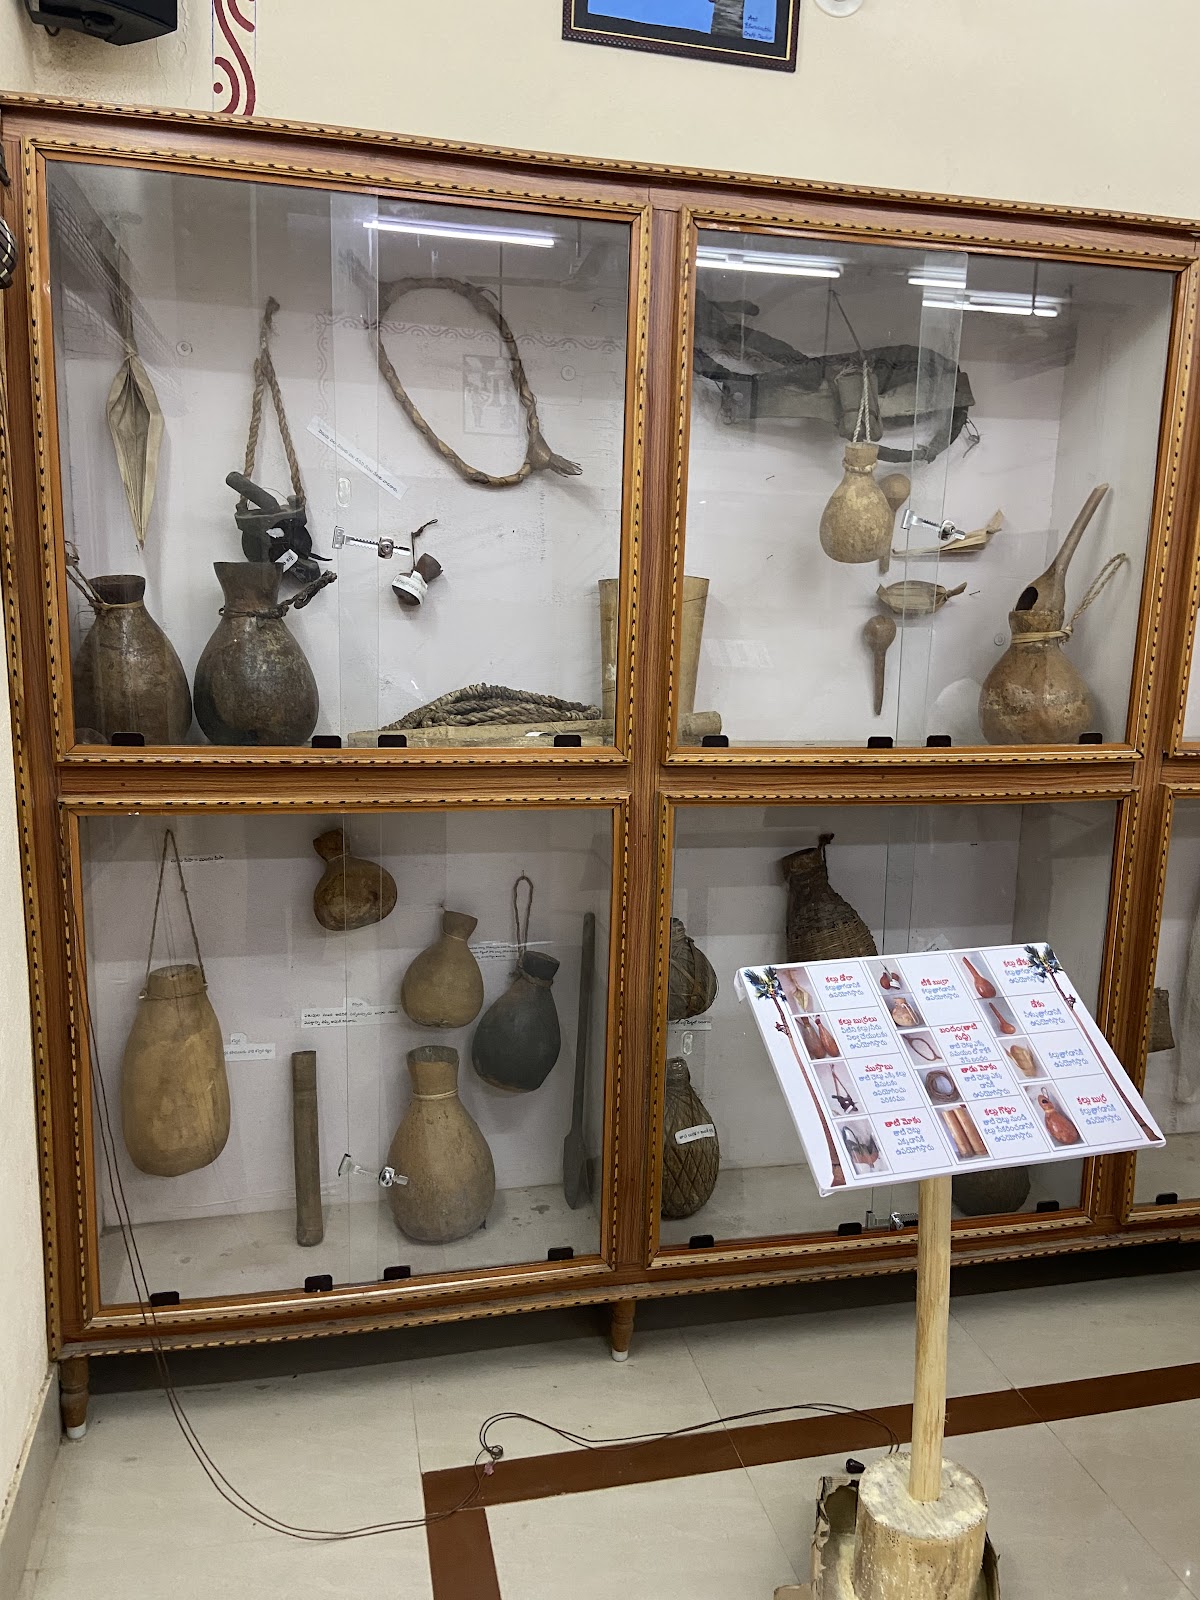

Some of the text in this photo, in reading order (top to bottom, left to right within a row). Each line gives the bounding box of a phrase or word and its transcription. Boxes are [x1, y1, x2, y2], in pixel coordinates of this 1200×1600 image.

[825, 976, 839, 984] కల్లు
[838, 1018, 852, 1026] కల్లు
[1076, 1095, 1091, 1105] కల్లు
[984, 1108, 998, 1116] కల్లు
[884, 1118, 900, 1128] తాటి
